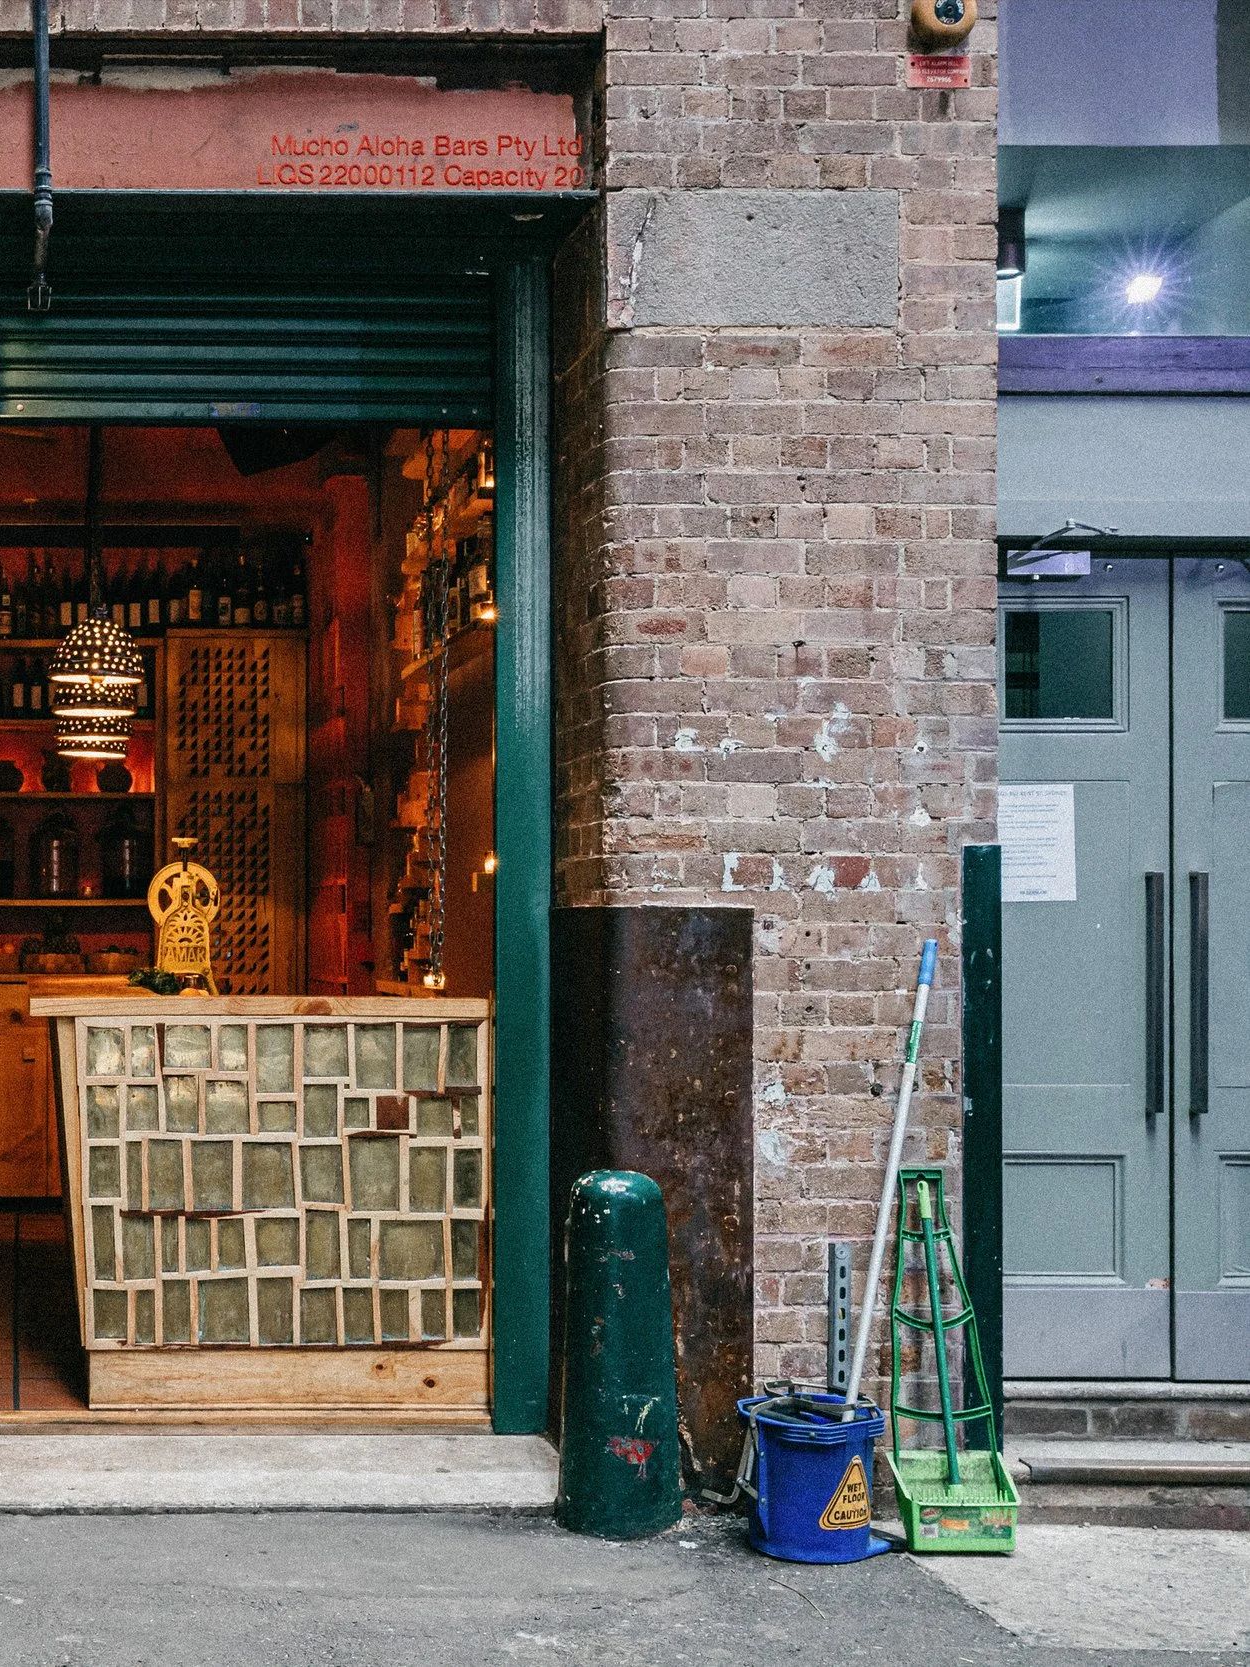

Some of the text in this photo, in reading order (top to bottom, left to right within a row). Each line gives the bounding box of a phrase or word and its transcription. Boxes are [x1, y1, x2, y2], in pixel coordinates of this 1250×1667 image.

[270, 134, 584, 161] Mucho Aloha Bars Pty Ltd
[444, 164, 547, 191] Capacity
[847, 1483, 862, 1493] WET
[842, 1492, 865, 1504] FLOOR
[834, 1507, 867, 1520] CAUTION
